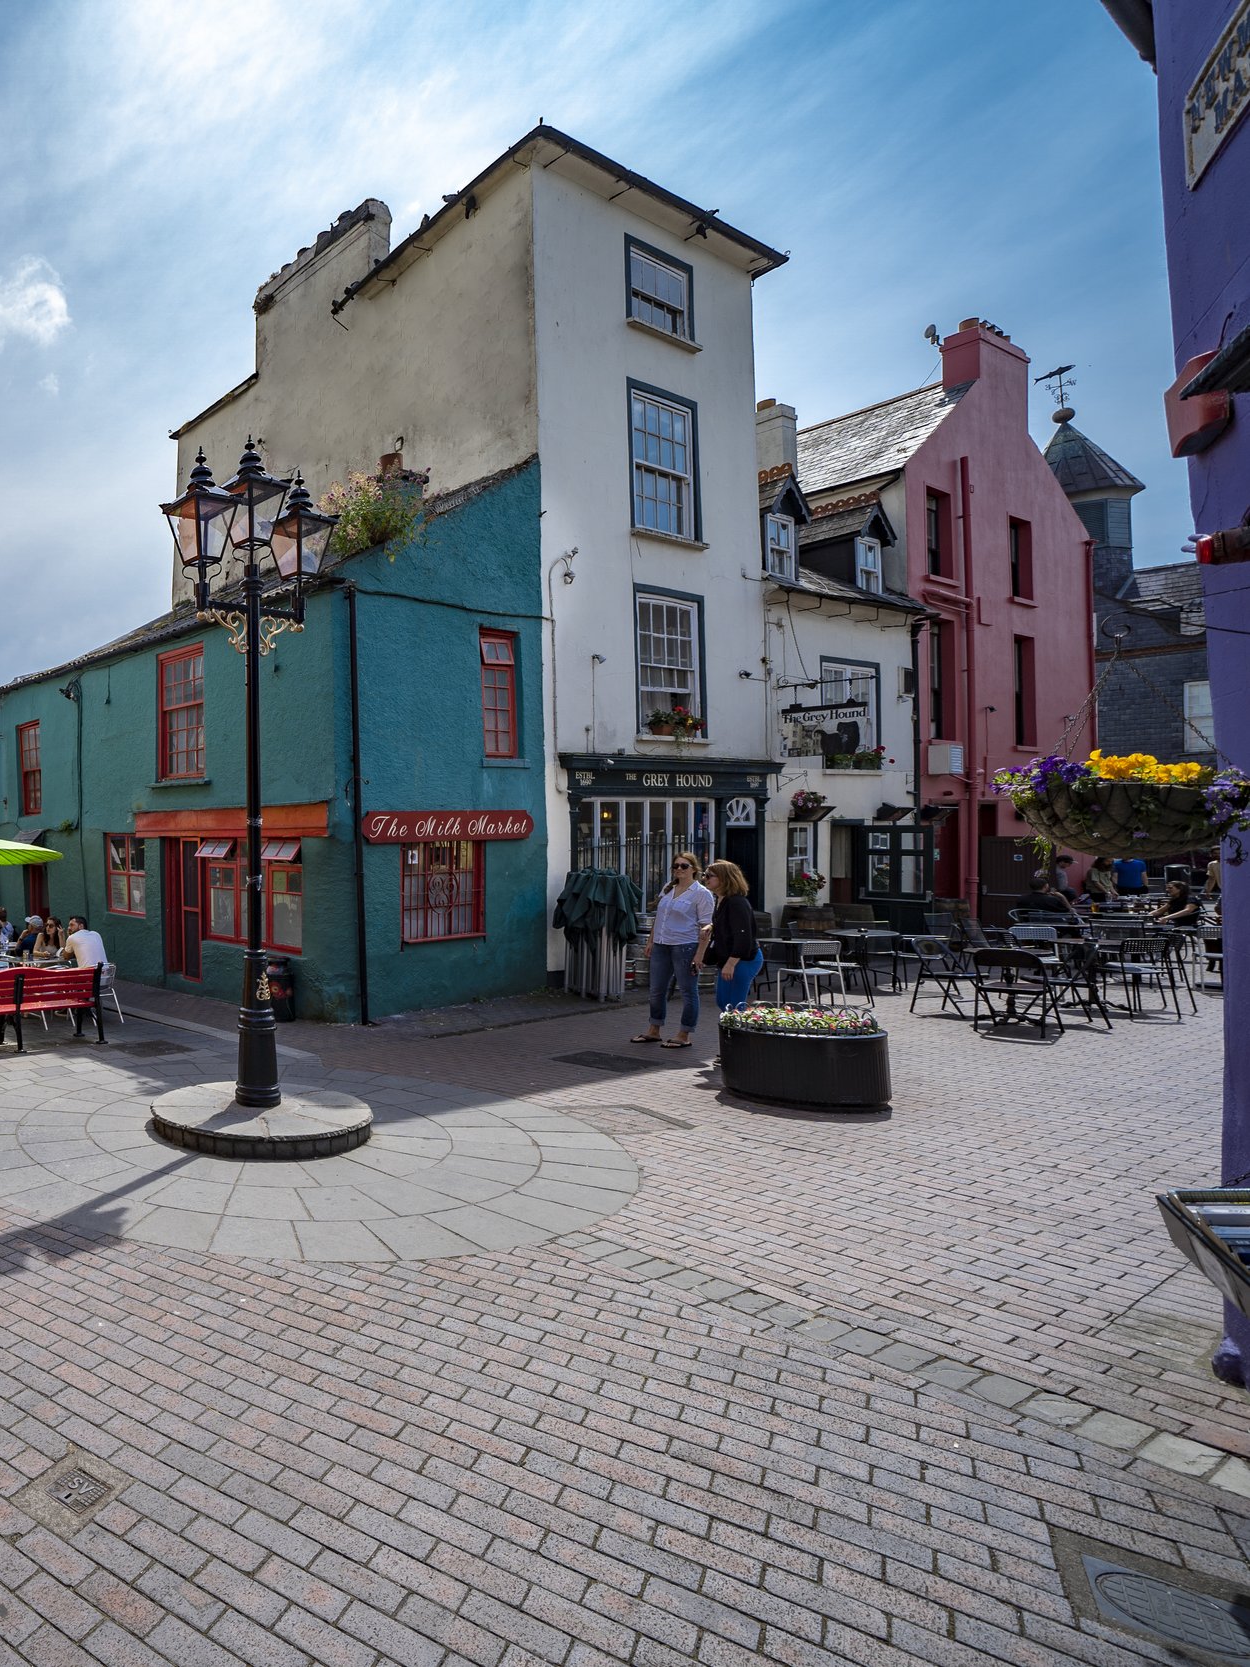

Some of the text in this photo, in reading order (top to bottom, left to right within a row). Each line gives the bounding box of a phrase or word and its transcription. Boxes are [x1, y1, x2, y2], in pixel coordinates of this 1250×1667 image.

[802, 711, 829, 723] Grey
[830, 707, 866, 720] Hound
[625, 773, 713, 788] THE GREY HOUND
[369, 814, 527, 839] The Milk Market
